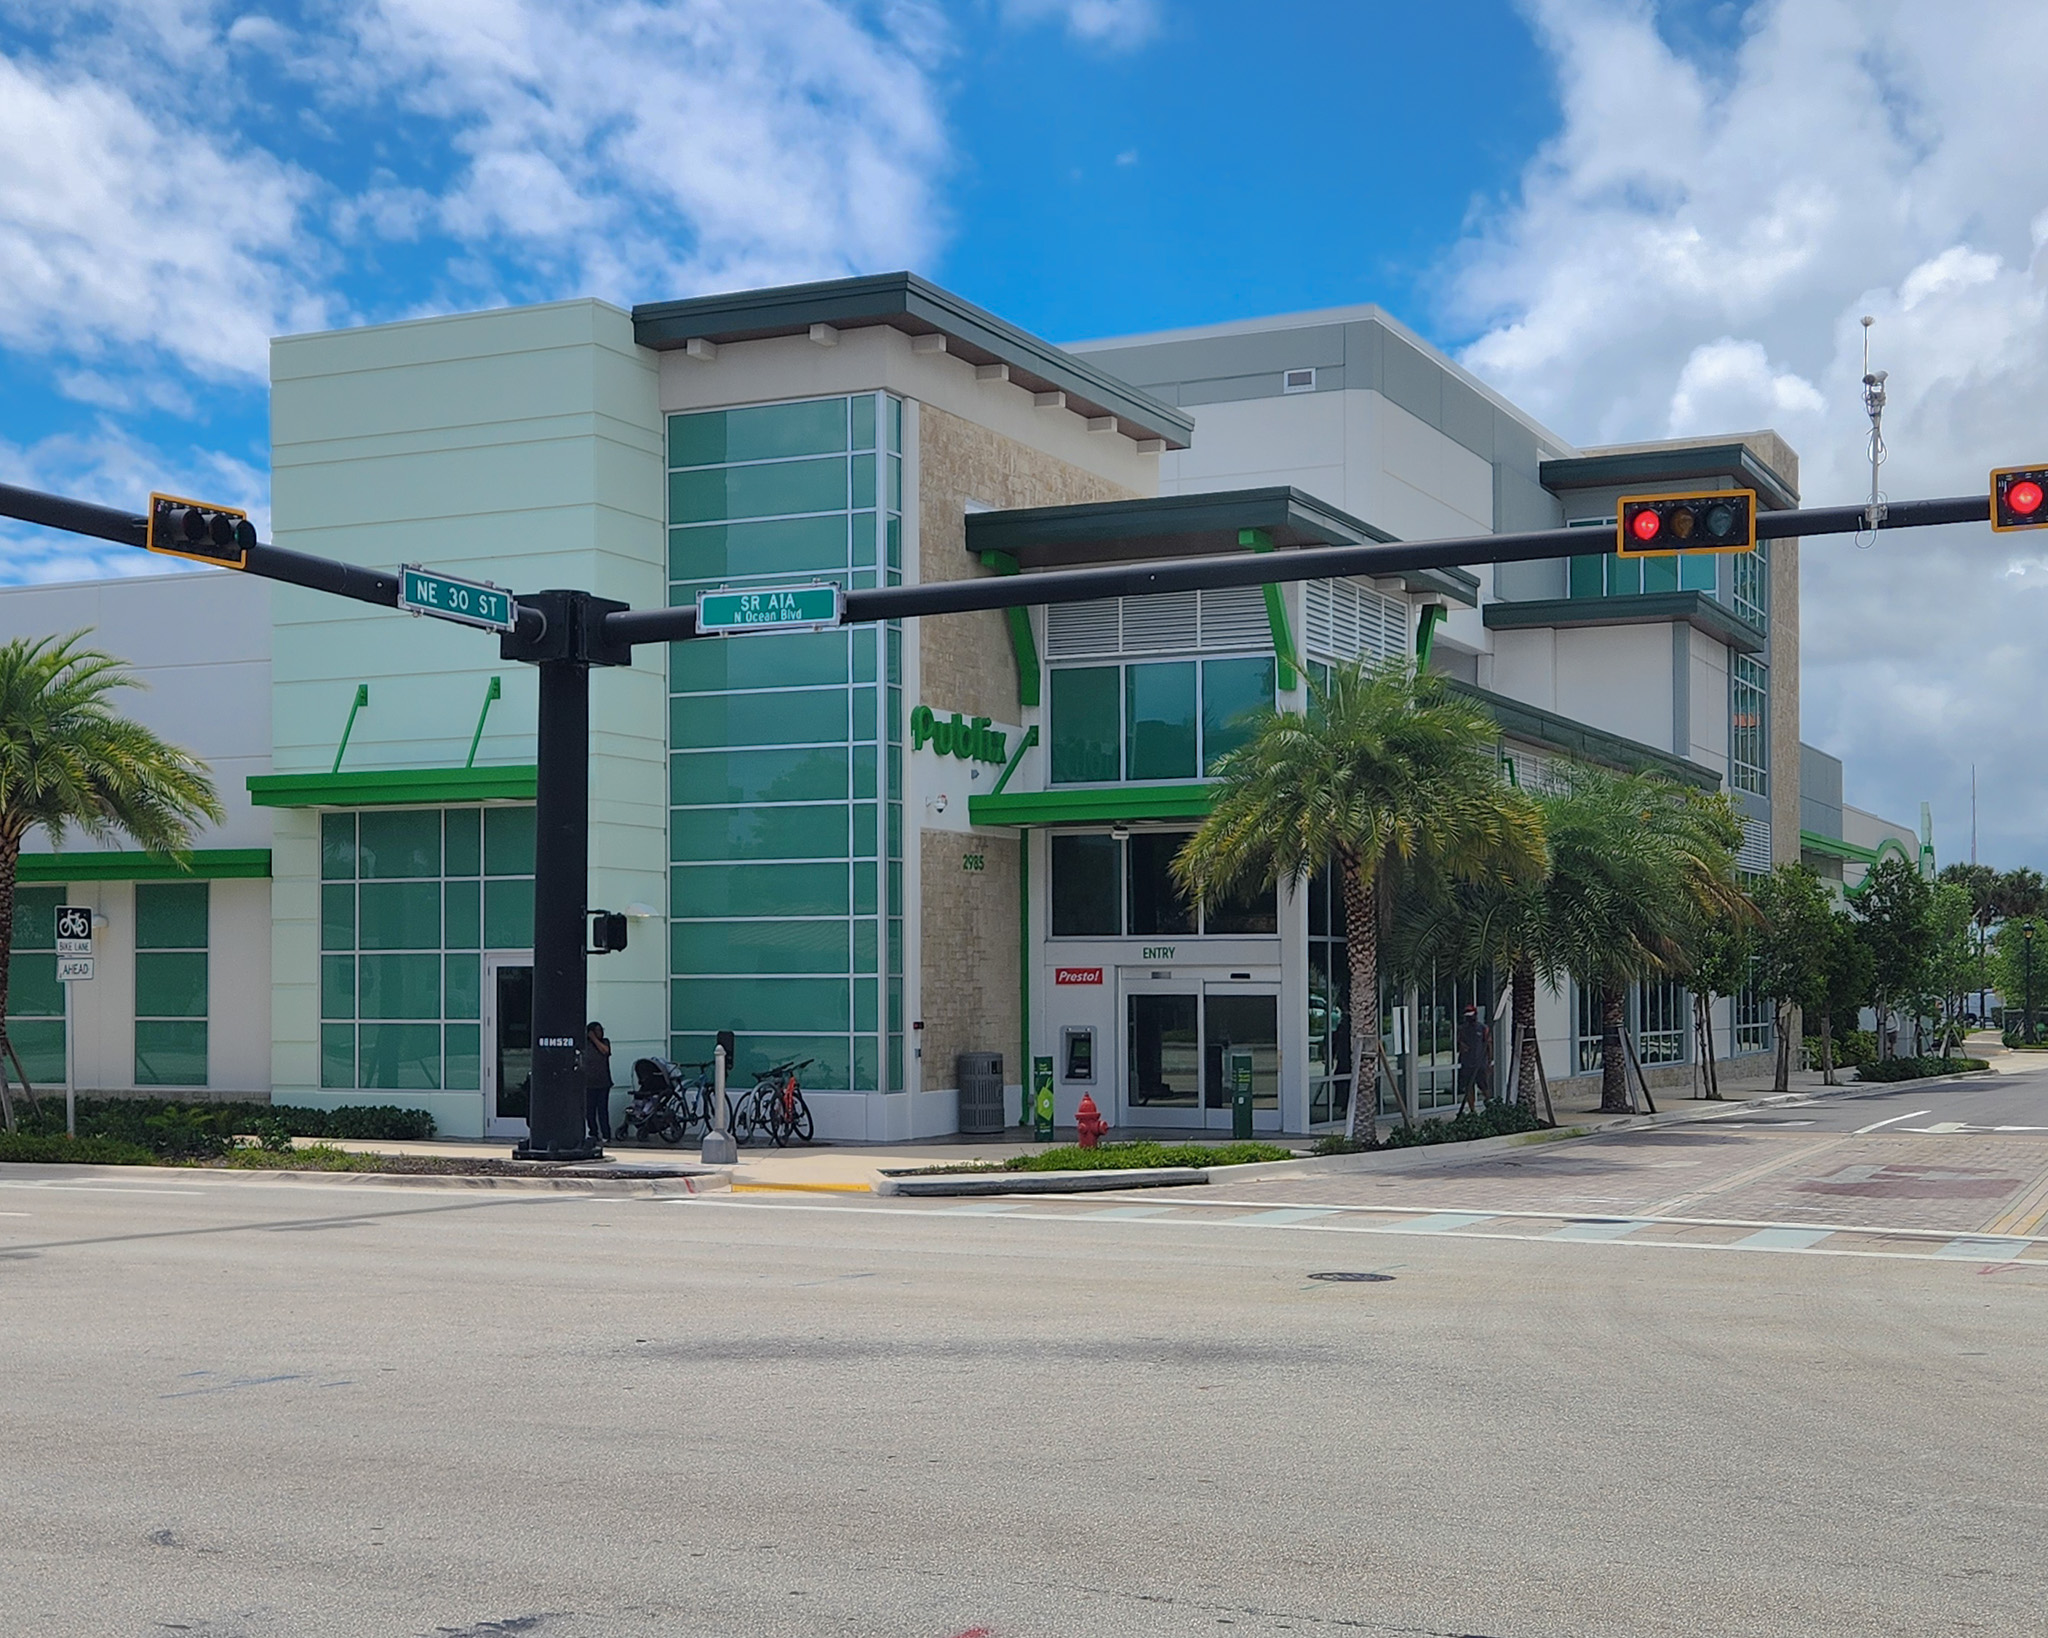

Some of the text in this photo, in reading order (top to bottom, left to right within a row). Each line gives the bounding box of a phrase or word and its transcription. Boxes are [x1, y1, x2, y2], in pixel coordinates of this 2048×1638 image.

[417, 579, 498, 617] NE 30 ST
[740, 593, 795, 611] SR A1A
[734, 608, 802, 623] N Ocean Blvd
[911, 705, 1007, 764] Publix
[963, 854, 985, 871] 2985
[59, 942, 89, 952] BIKE LANE
[1143, 947, 1176, 959] ENTRY
[63, 963, 89, 975] AHEAD
[1058, 971, 1099, 982] Presto!
